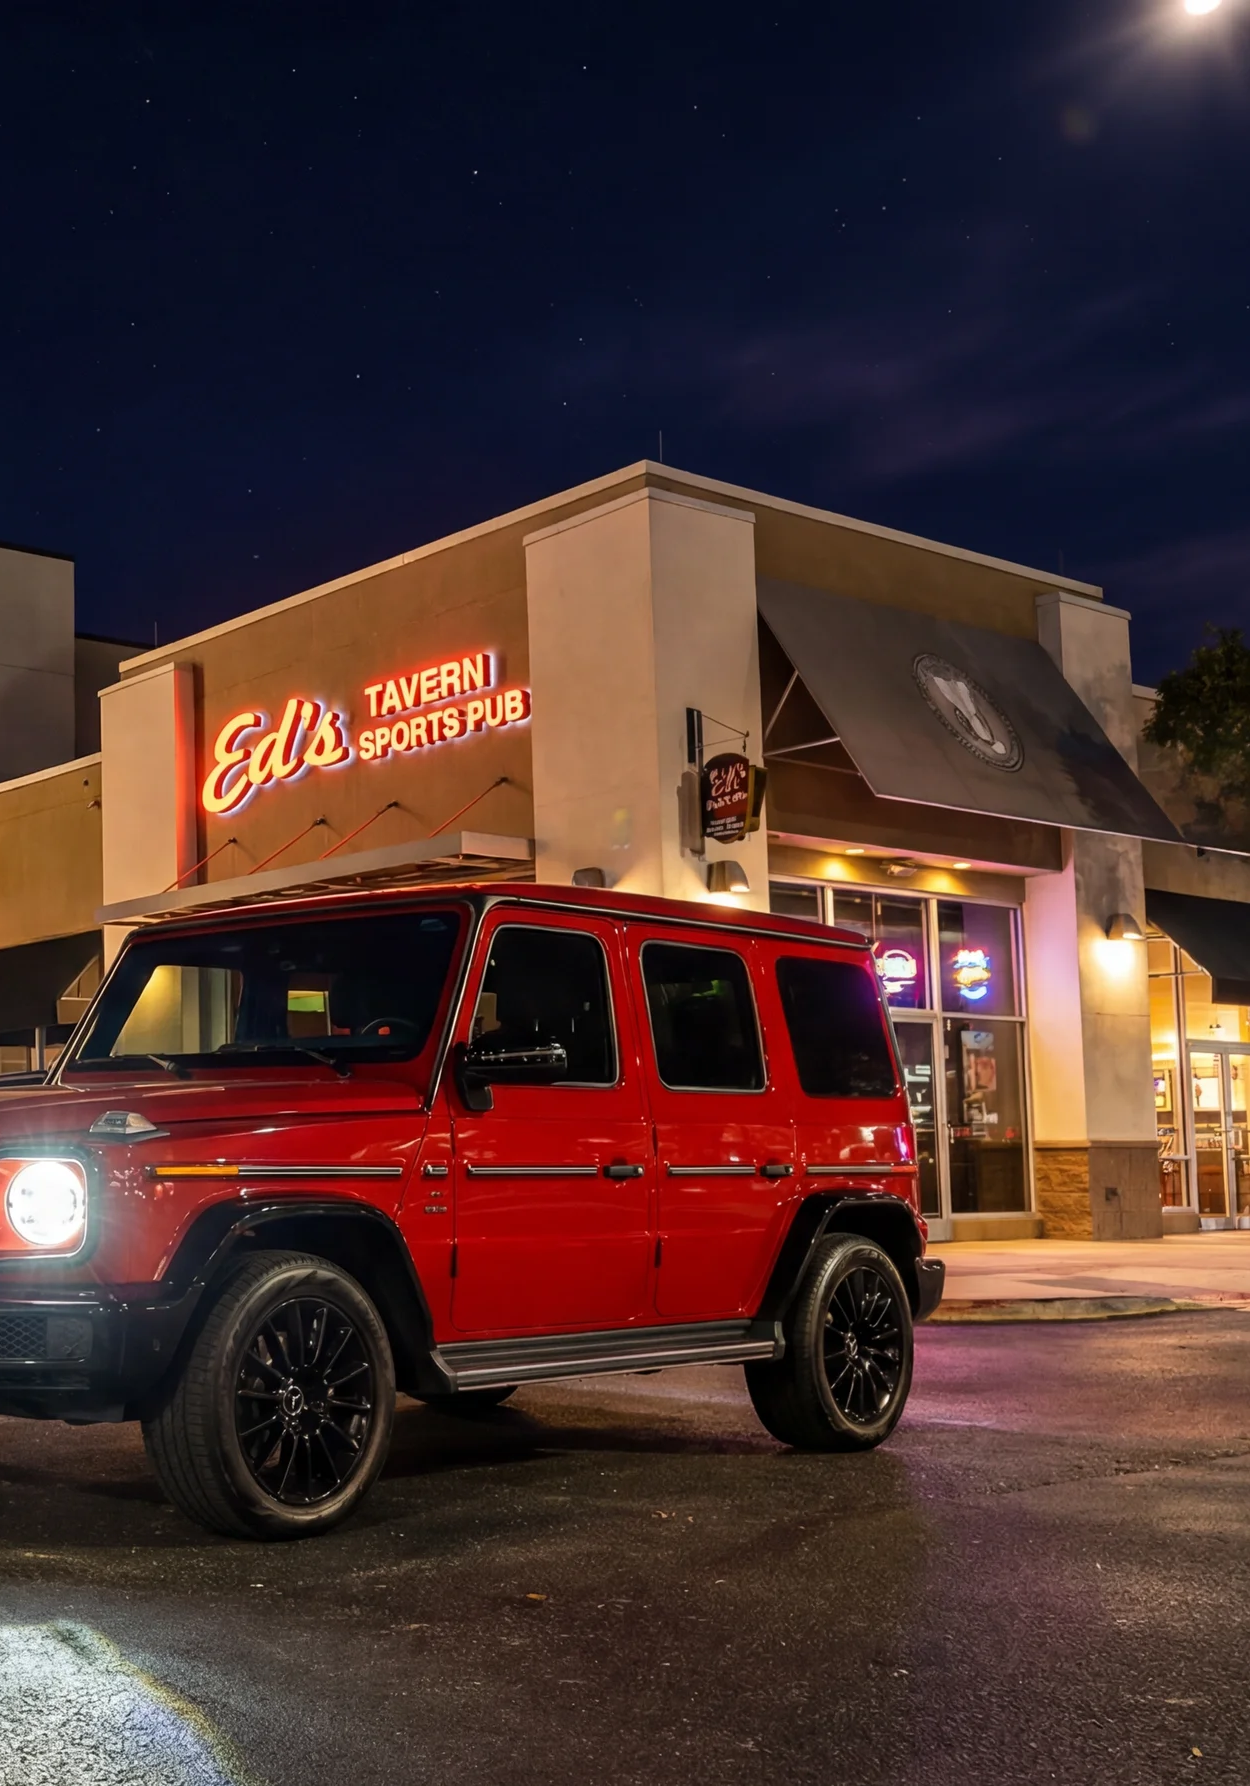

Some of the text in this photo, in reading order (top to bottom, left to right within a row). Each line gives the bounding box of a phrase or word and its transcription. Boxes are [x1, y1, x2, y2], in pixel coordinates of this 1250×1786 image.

[363, 653, 493, 718] TAVERN
[202, 698, 349, 813] Ed's
[359, 689, 532, 760] SPORTS PUB
